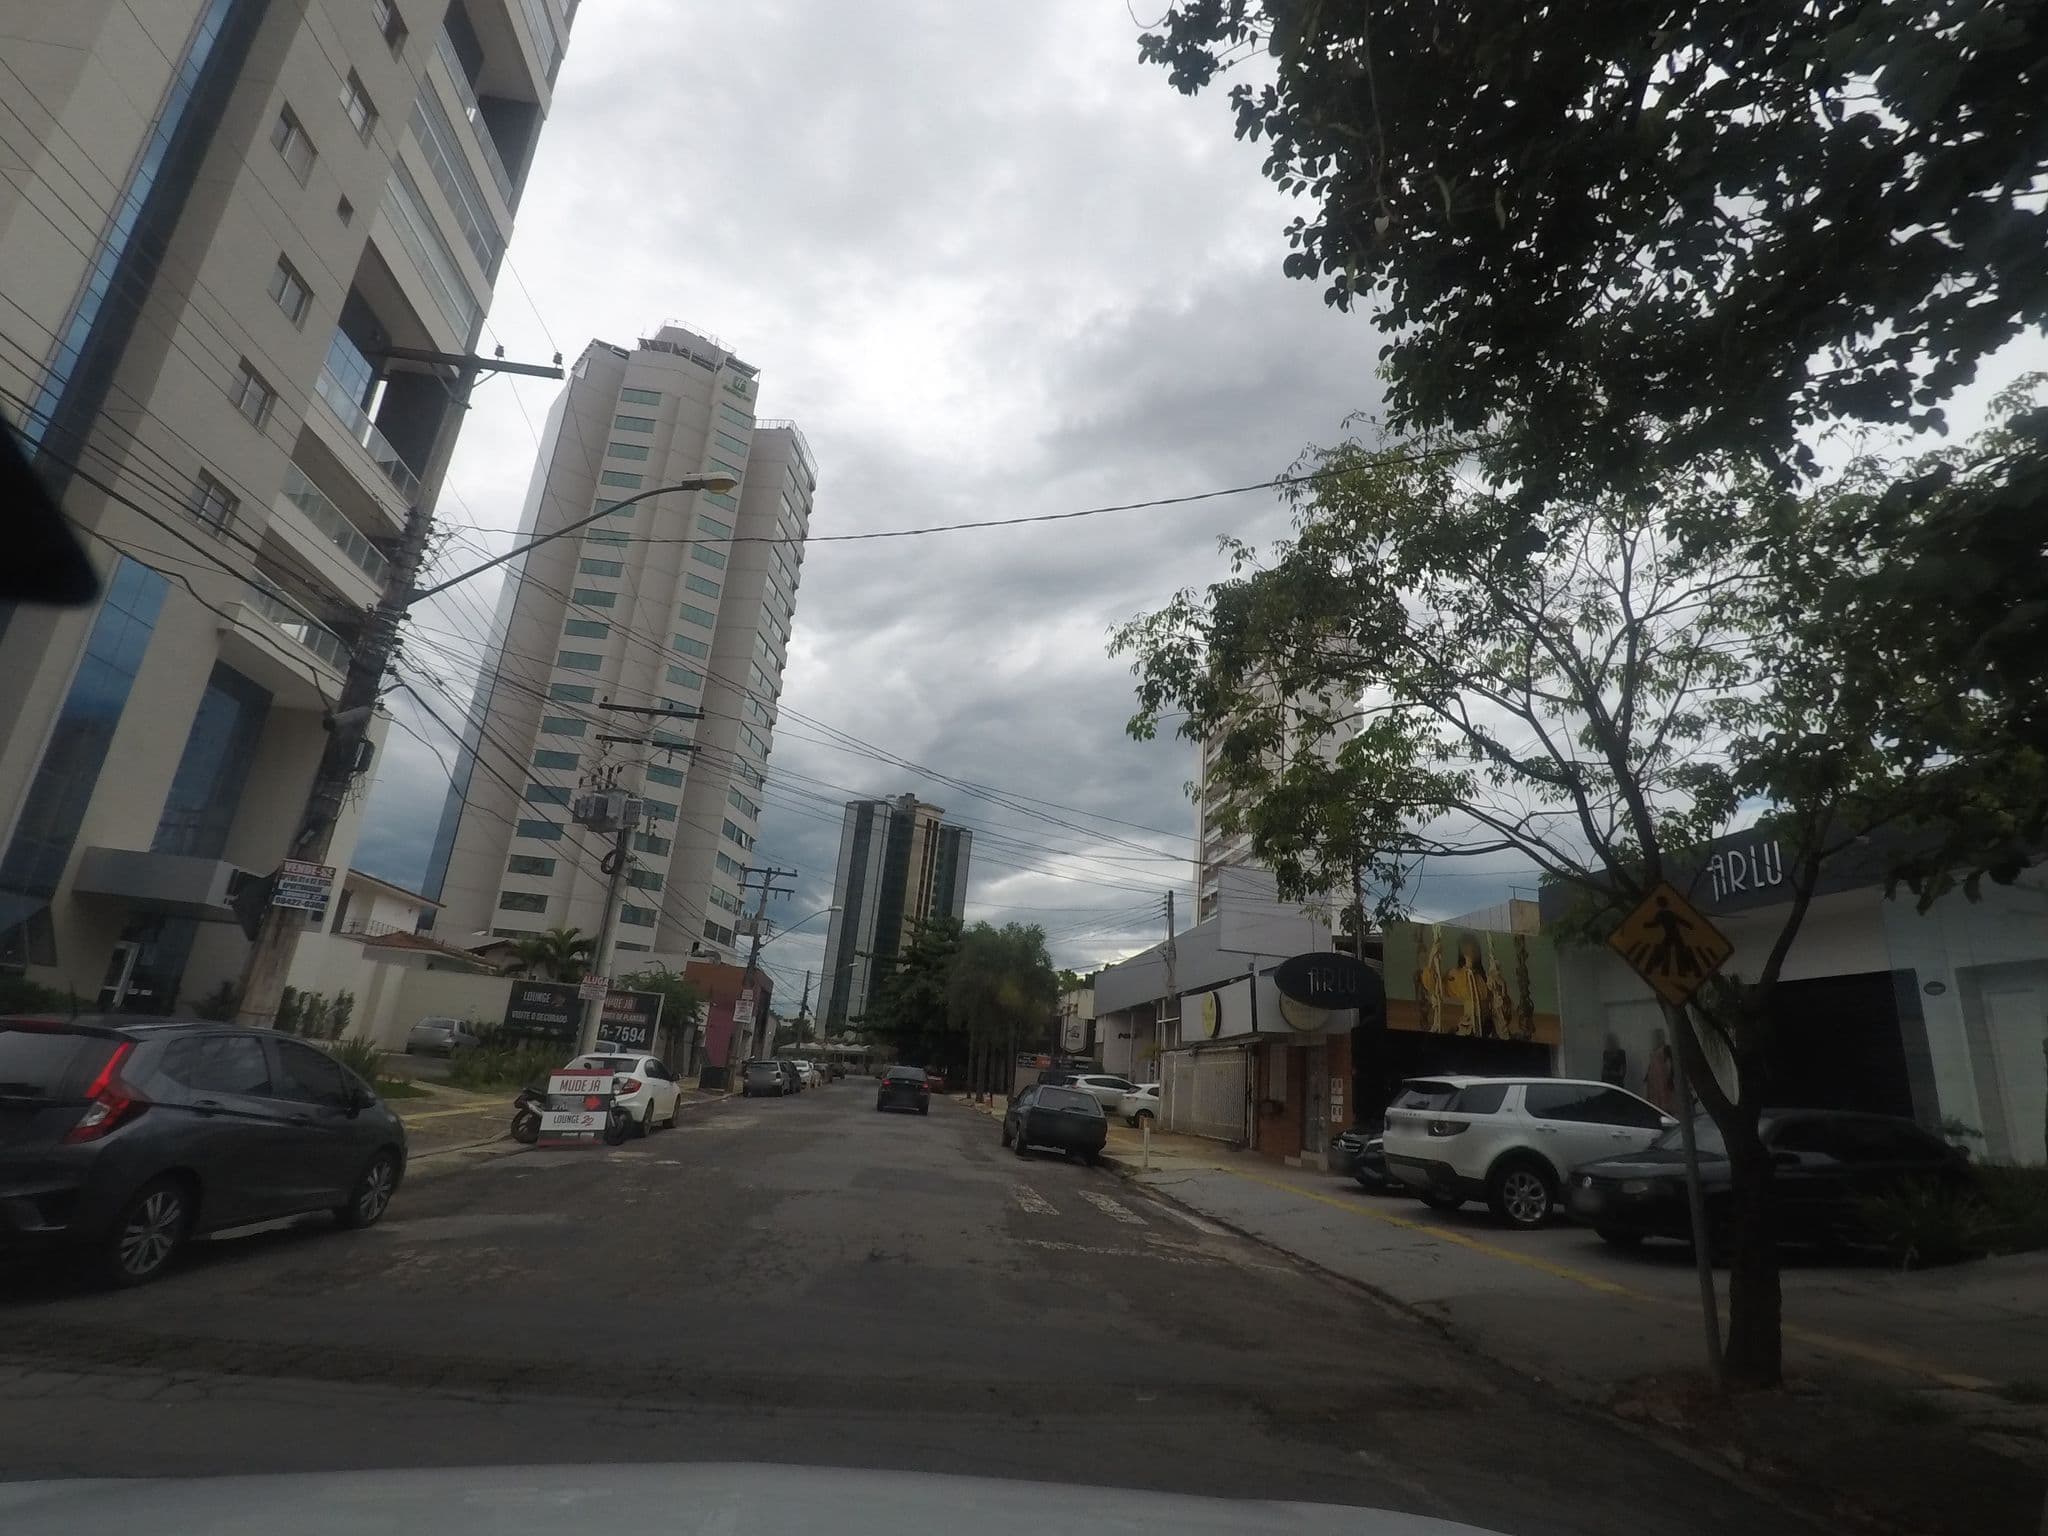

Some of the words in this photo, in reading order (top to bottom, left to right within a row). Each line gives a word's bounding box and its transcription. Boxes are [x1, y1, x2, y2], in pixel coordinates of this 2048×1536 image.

[1706, 840, 1783, 902] ARLU
[523, 991, 552, 1004] LOUNGE
[560, 1079, 588, 1092] MUDE
[553, 1115, 580, 1125] LOUNGE
